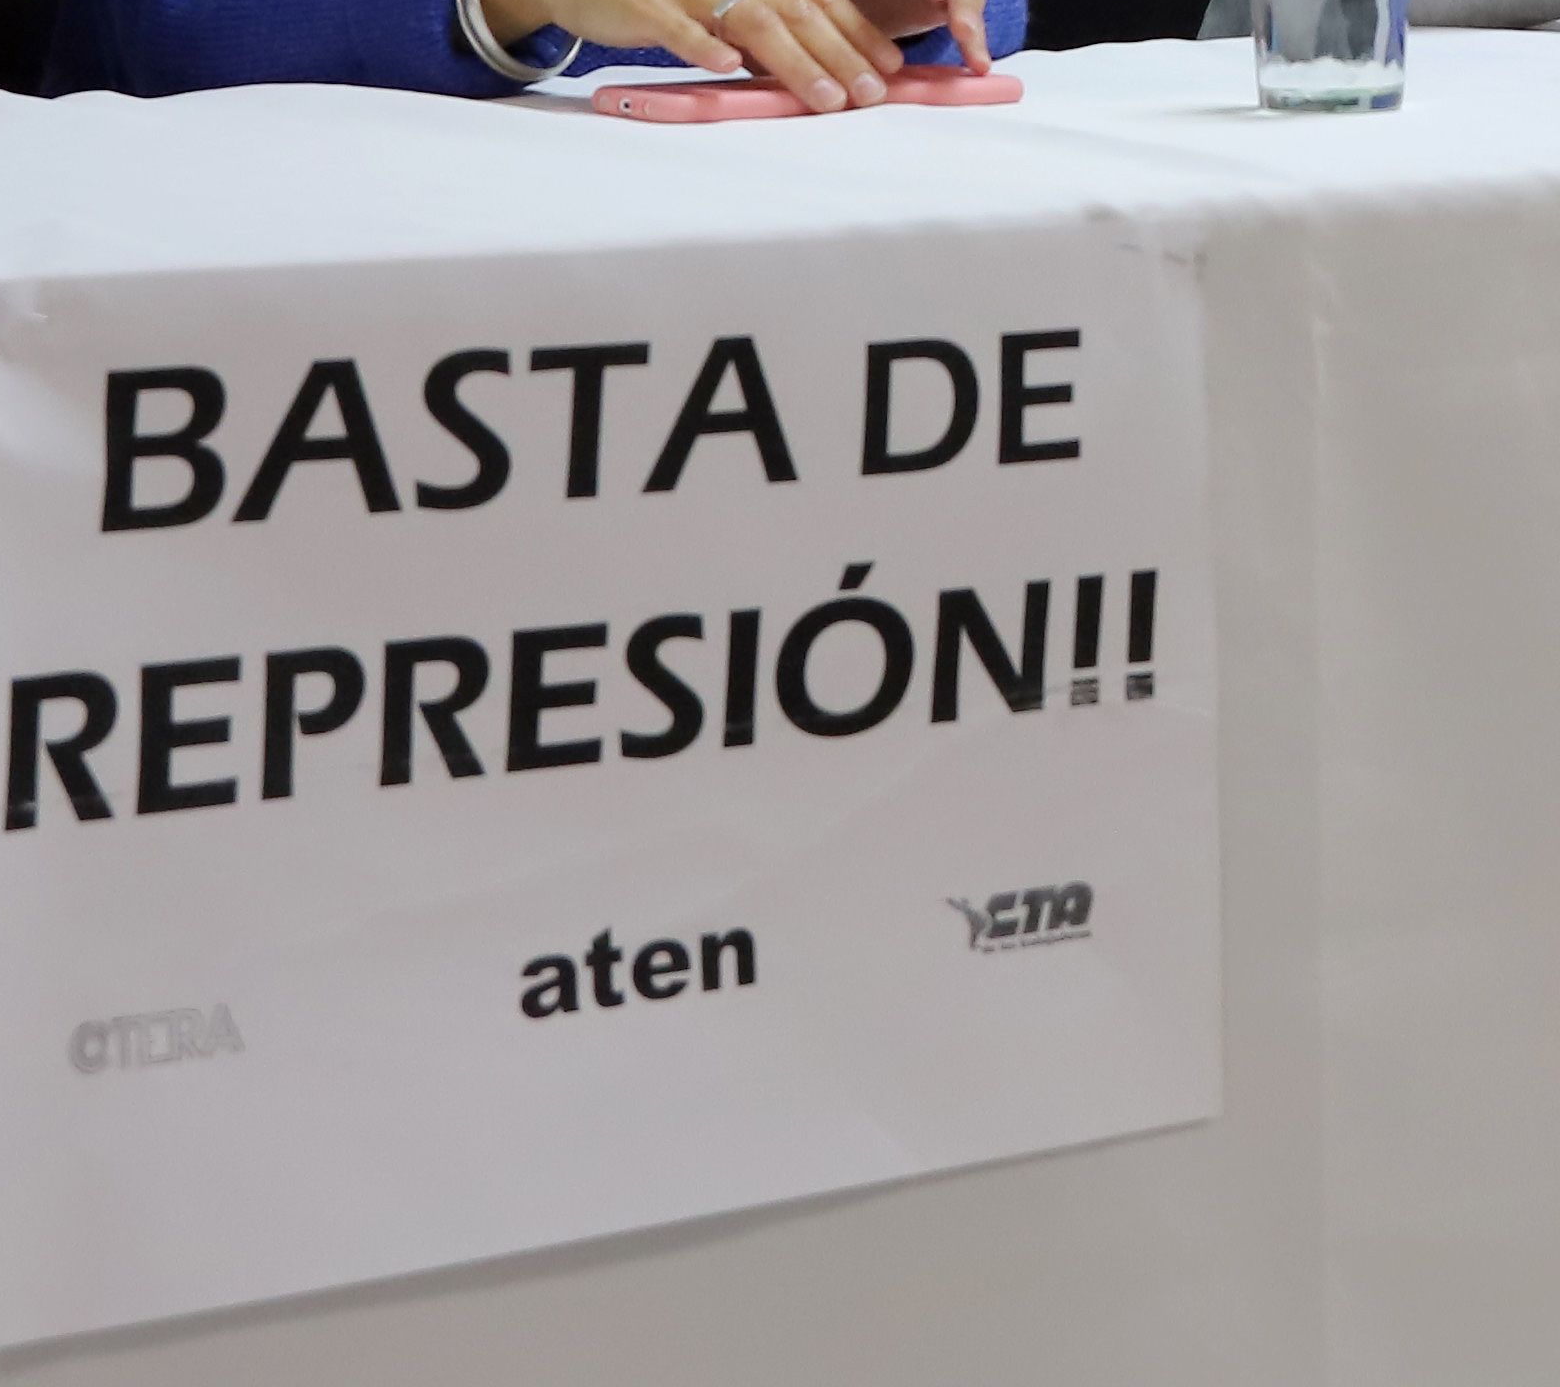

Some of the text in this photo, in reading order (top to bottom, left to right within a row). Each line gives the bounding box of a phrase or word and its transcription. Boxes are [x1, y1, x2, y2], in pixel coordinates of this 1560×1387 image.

[100, 328, 1082, 532] BASTA DE
[3, 561, 1159, 832] REPRESIÓN!!
[520, 927, 758, 1019] aten
